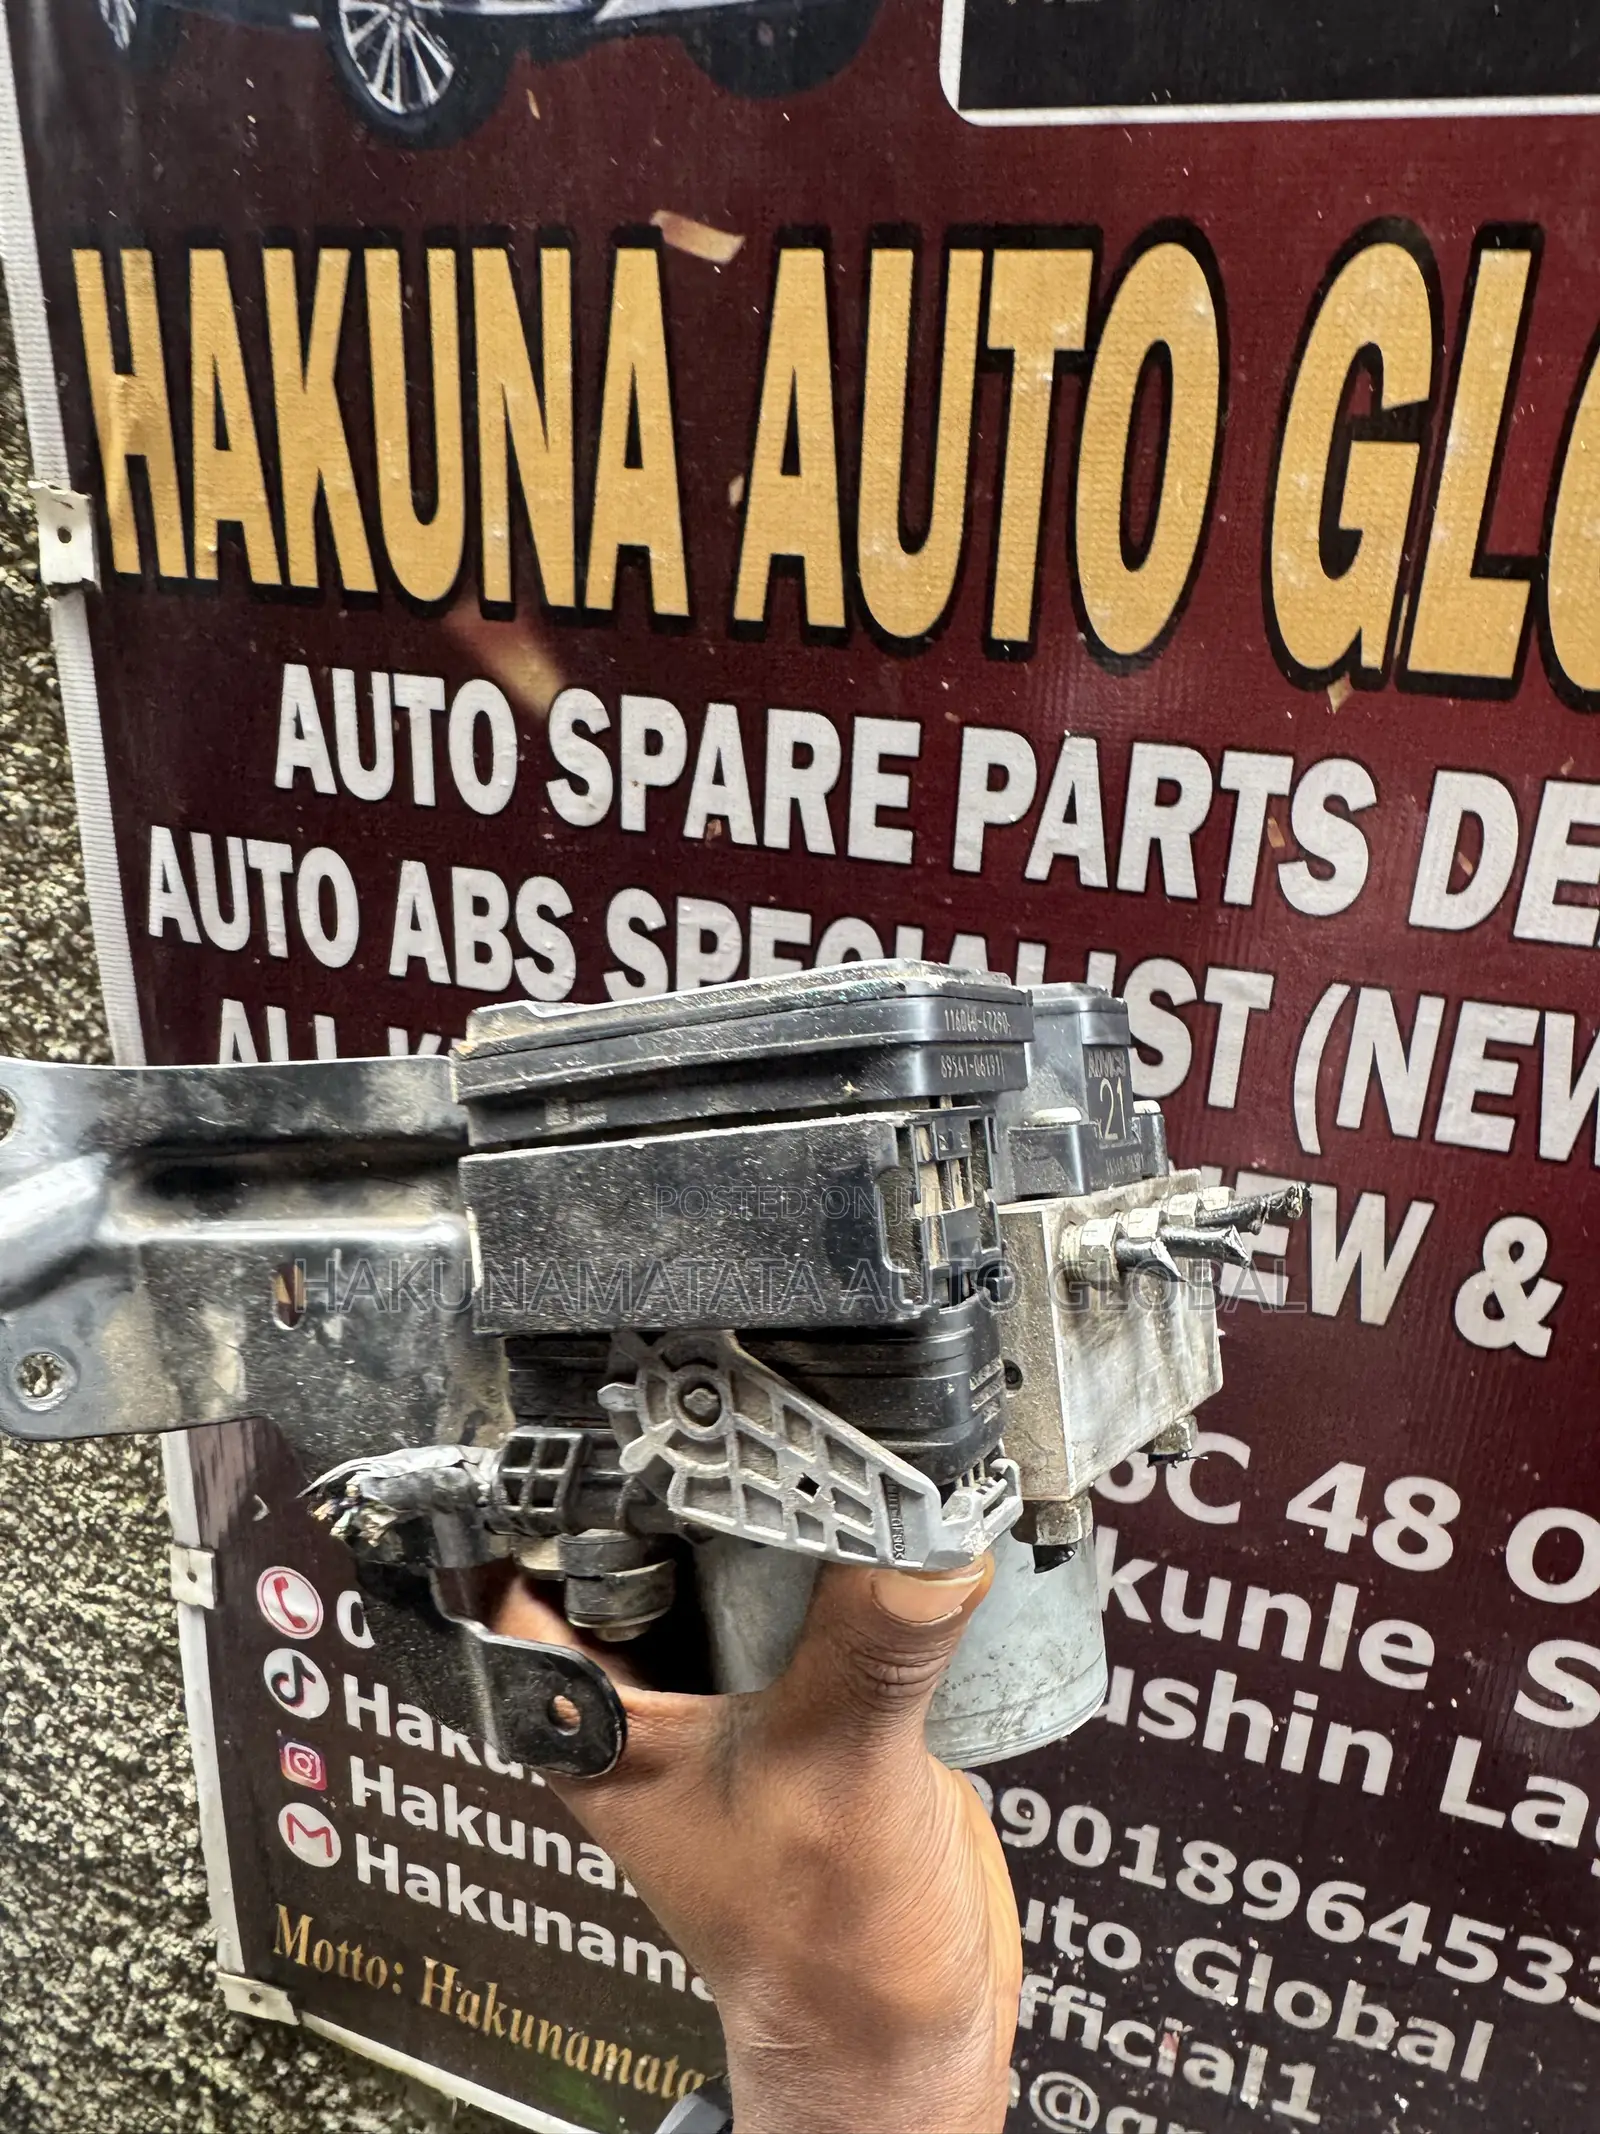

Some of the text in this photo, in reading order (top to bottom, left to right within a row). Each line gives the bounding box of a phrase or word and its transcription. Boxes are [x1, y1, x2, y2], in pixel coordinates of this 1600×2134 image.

[72, 246, 690, 618] HAKUNA
[733, 241, 1220, 656] AUTO
[275, 663, 1600, 947] AUTO SPARE PARTS DE
[148, 825, 360, 969] AUTO
[388, 860, 577, 1001] ABS
[1099, 1077, 1127, 1141] 21
[1200, 1165, 1563, 1358] EW &
[1286, 1460, 1461, 1573] 48
[350, 1755, 639, 1898] Hakuna
[1440, 1737, 1600, 1877] La
[273, 1904, 405, 1996] Motto:
[1174, 1937, 1494, 2083] Global
